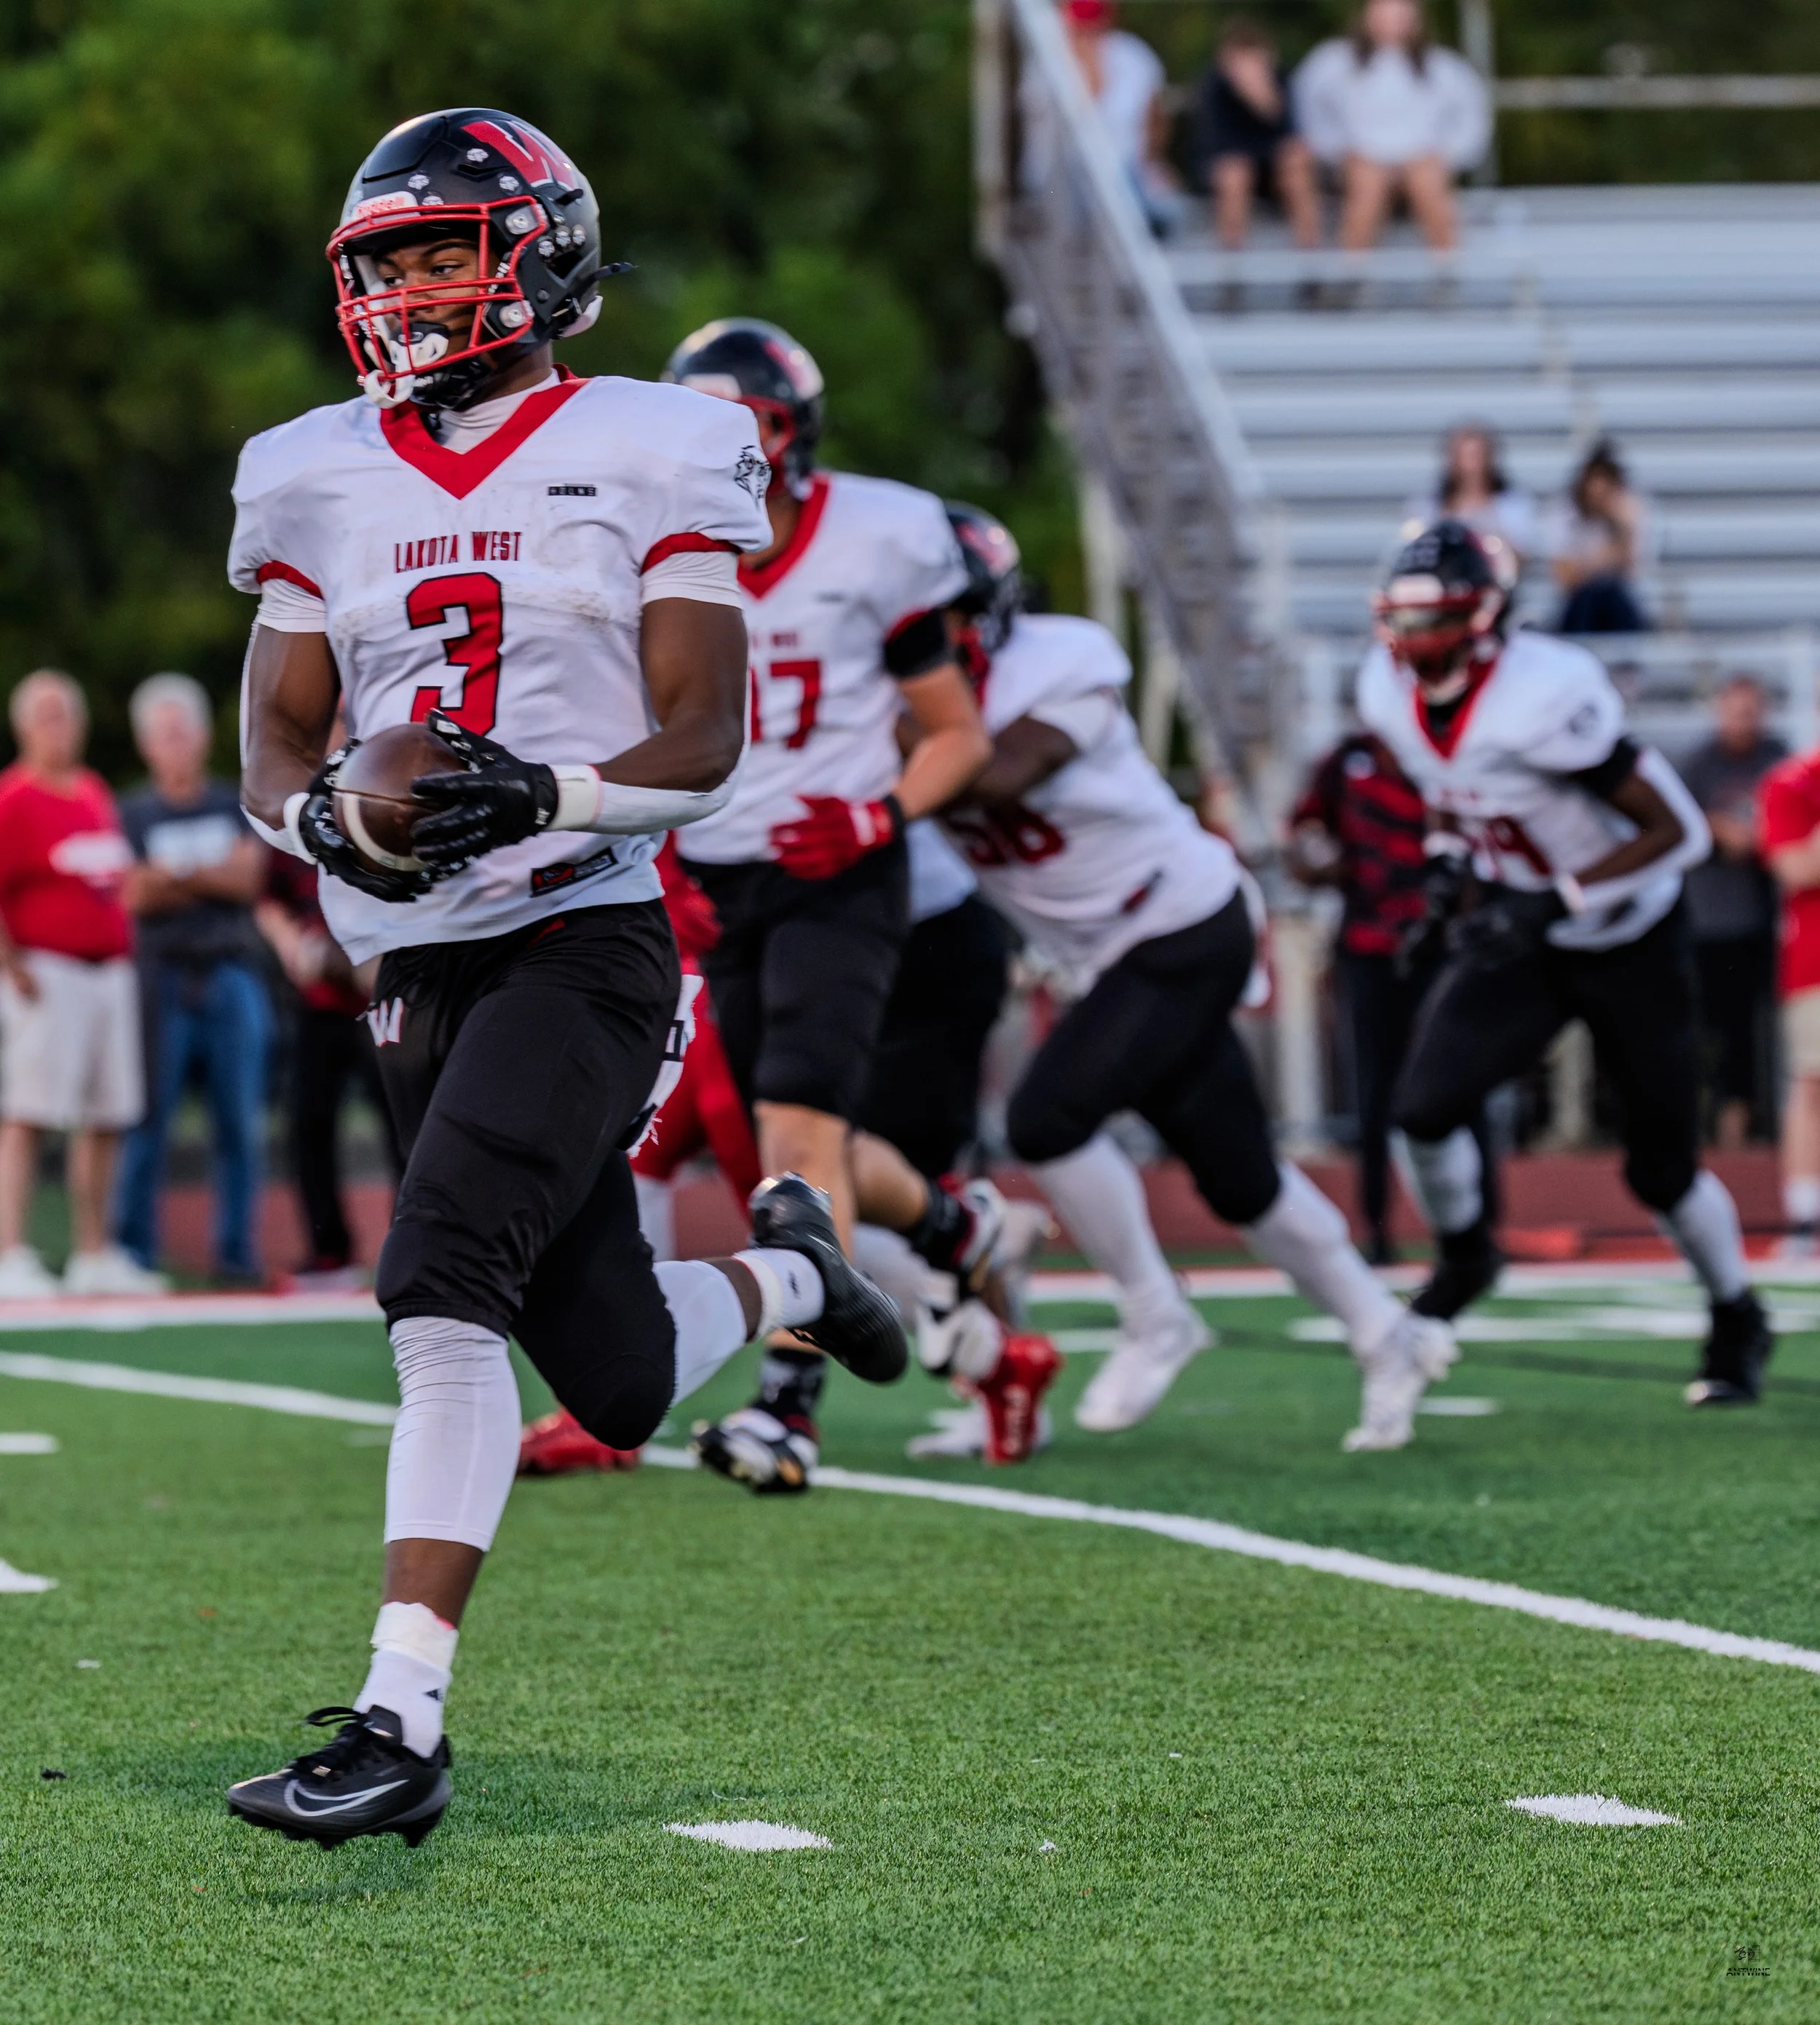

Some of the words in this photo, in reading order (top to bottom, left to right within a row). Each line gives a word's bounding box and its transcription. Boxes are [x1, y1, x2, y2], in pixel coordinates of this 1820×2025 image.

[395, 534, 459, 573] LAKOTA
[472, 531, 521, 561] WEST
[406, 572, 503, 737] 3
[366, 996, 403, 1047] W
